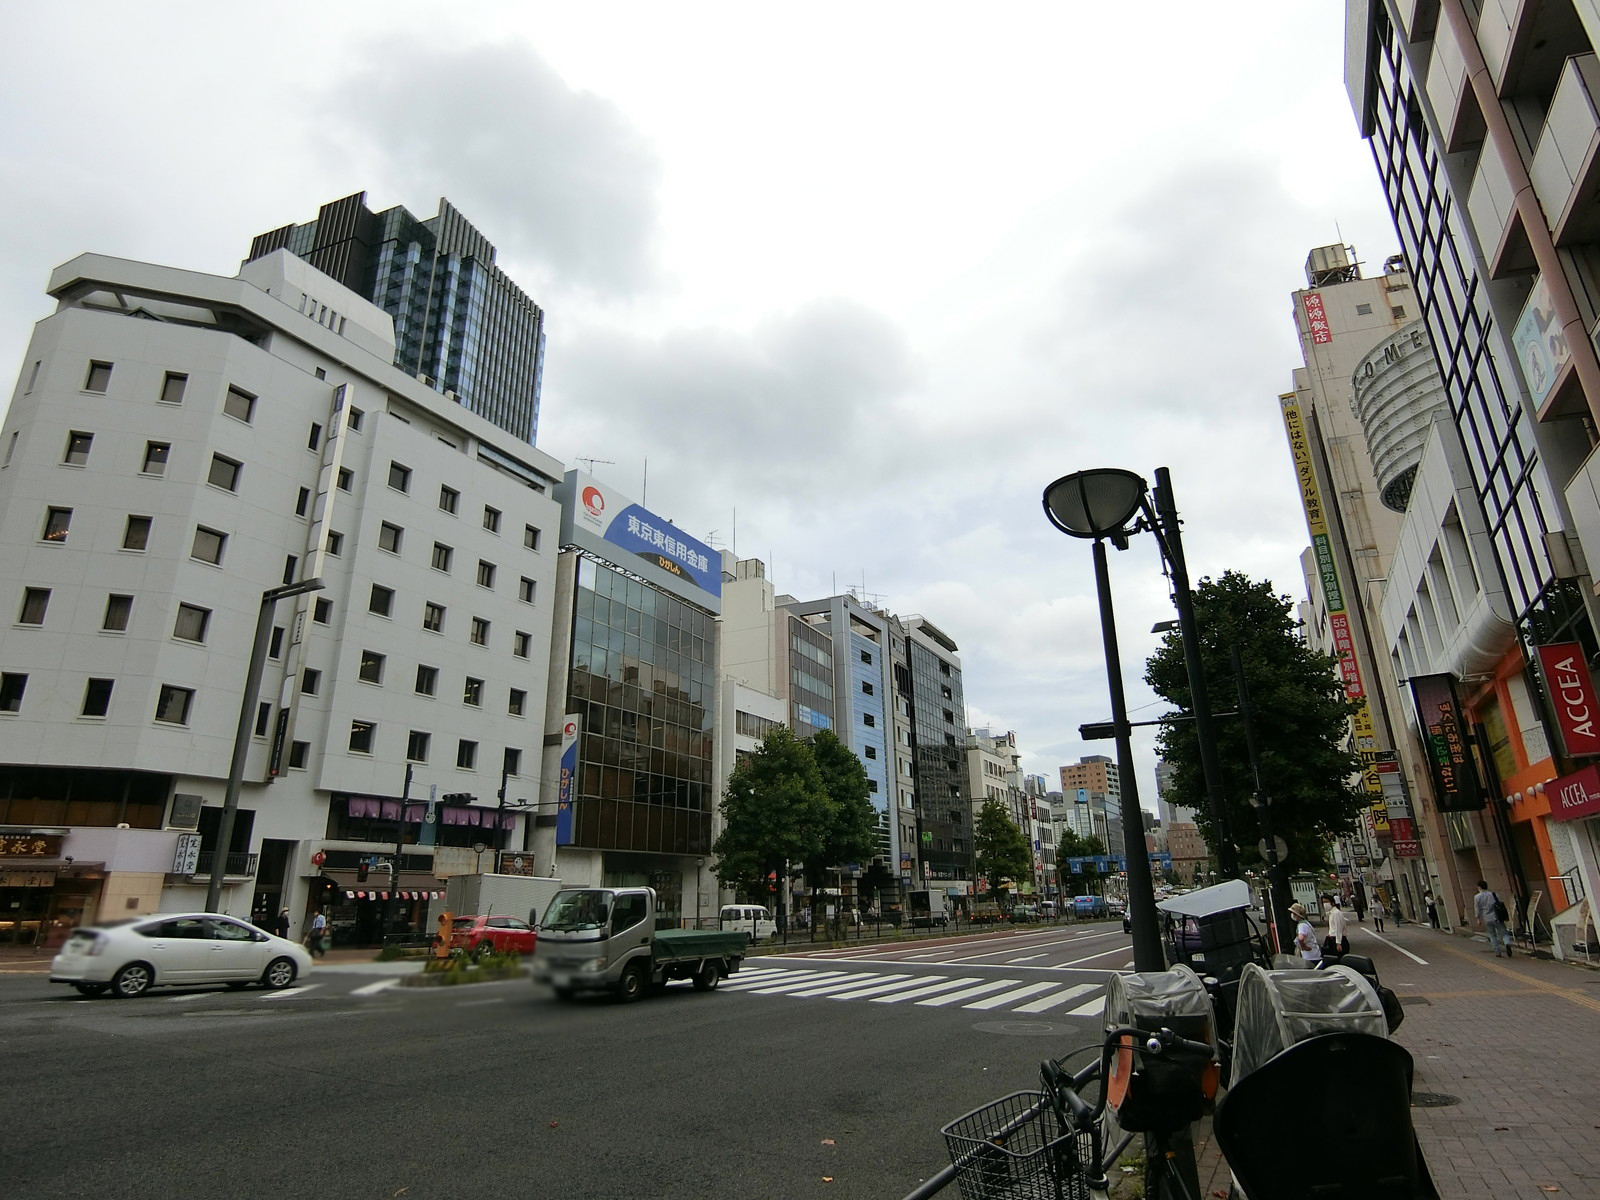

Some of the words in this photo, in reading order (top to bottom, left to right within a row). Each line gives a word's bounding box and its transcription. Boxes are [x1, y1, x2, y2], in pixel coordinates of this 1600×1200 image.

[1306, 296, 1328, 343] 源源飯店
[627, 514, 709, 574] 東京東信用金庫
[658, 556, 681, 576] ひがしん
[1315, 535, 1344, 611] 科目別能力別授業
[1554, 656, 1596, 738] ACCEA
[559, 767, 570, 811] ひがしん
[1559, 782, 1590, 809] ACCEA
